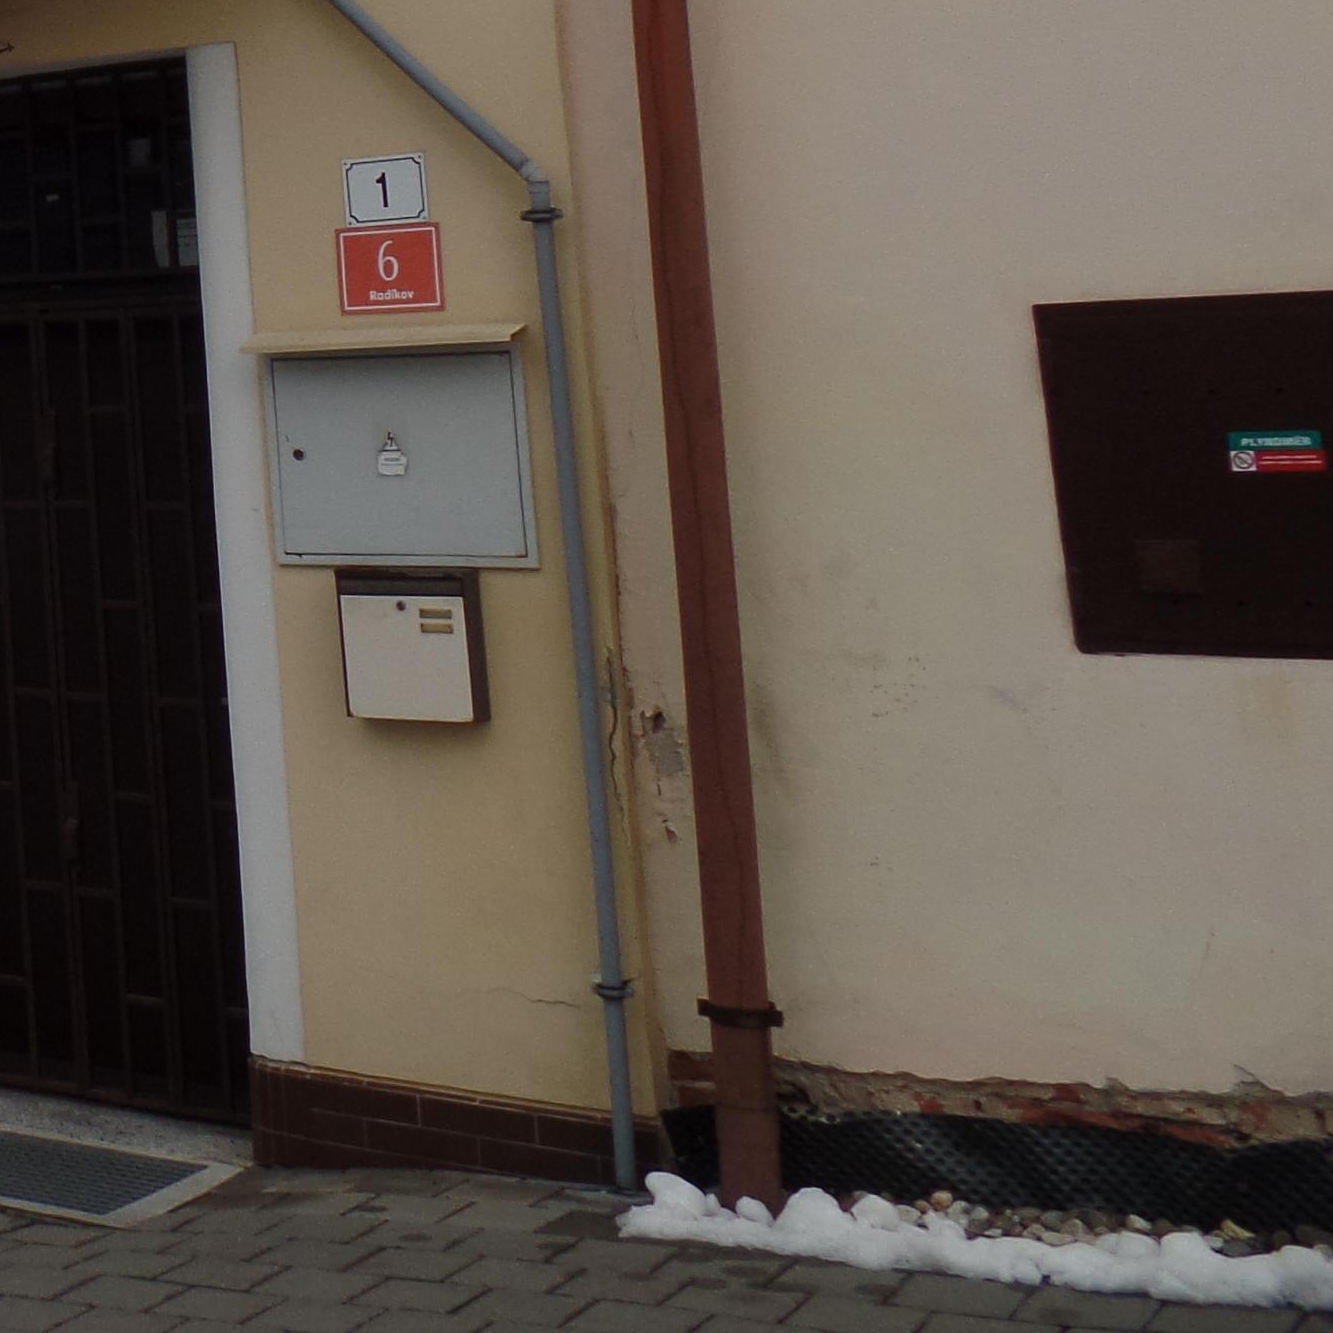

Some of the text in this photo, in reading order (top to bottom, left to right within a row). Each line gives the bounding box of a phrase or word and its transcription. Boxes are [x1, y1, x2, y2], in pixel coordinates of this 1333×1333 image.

[375, 171, 389, 208] 1
[378, 240, 400, 281] 6
[369, 288, 415, 301] Radíkov
